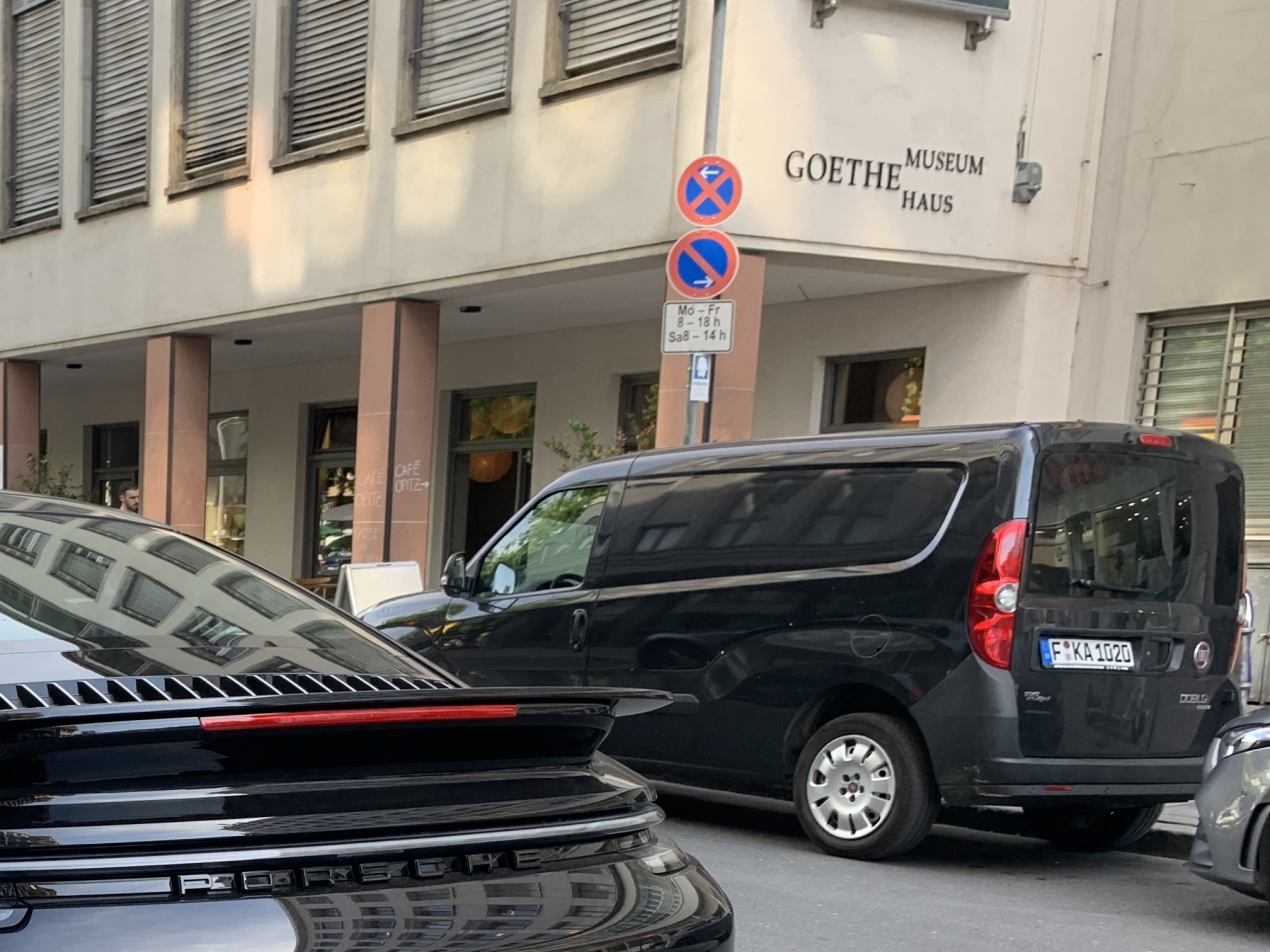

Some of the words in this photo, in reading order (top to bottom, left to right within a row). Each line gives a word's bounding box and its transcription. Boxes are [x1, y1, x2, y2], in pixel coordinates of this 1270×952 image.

[785, 150, 902, 191] GOETHE
[905, 147, 985, 175] MUSEUM
[901, 190, 954, 213] HAUS
[677, 305, 695, 316] Mo
[708, 304, 720, 315] Fr
[677, 317, 684, 328] 8
[699, 317, 712, 328] 18
[714, 317, 720, 327] h
[703, 330, 716, 341] 14
[719, 330, 726, 341] h
[394, 459, 421, 478] CAFÉ
[1051, 641, 1061, 661] F
[1072, 641, 1094, 662] KA
[1095, 643, 1131, 663] 1020
[177, 848, 543, 896] PORSCHE
